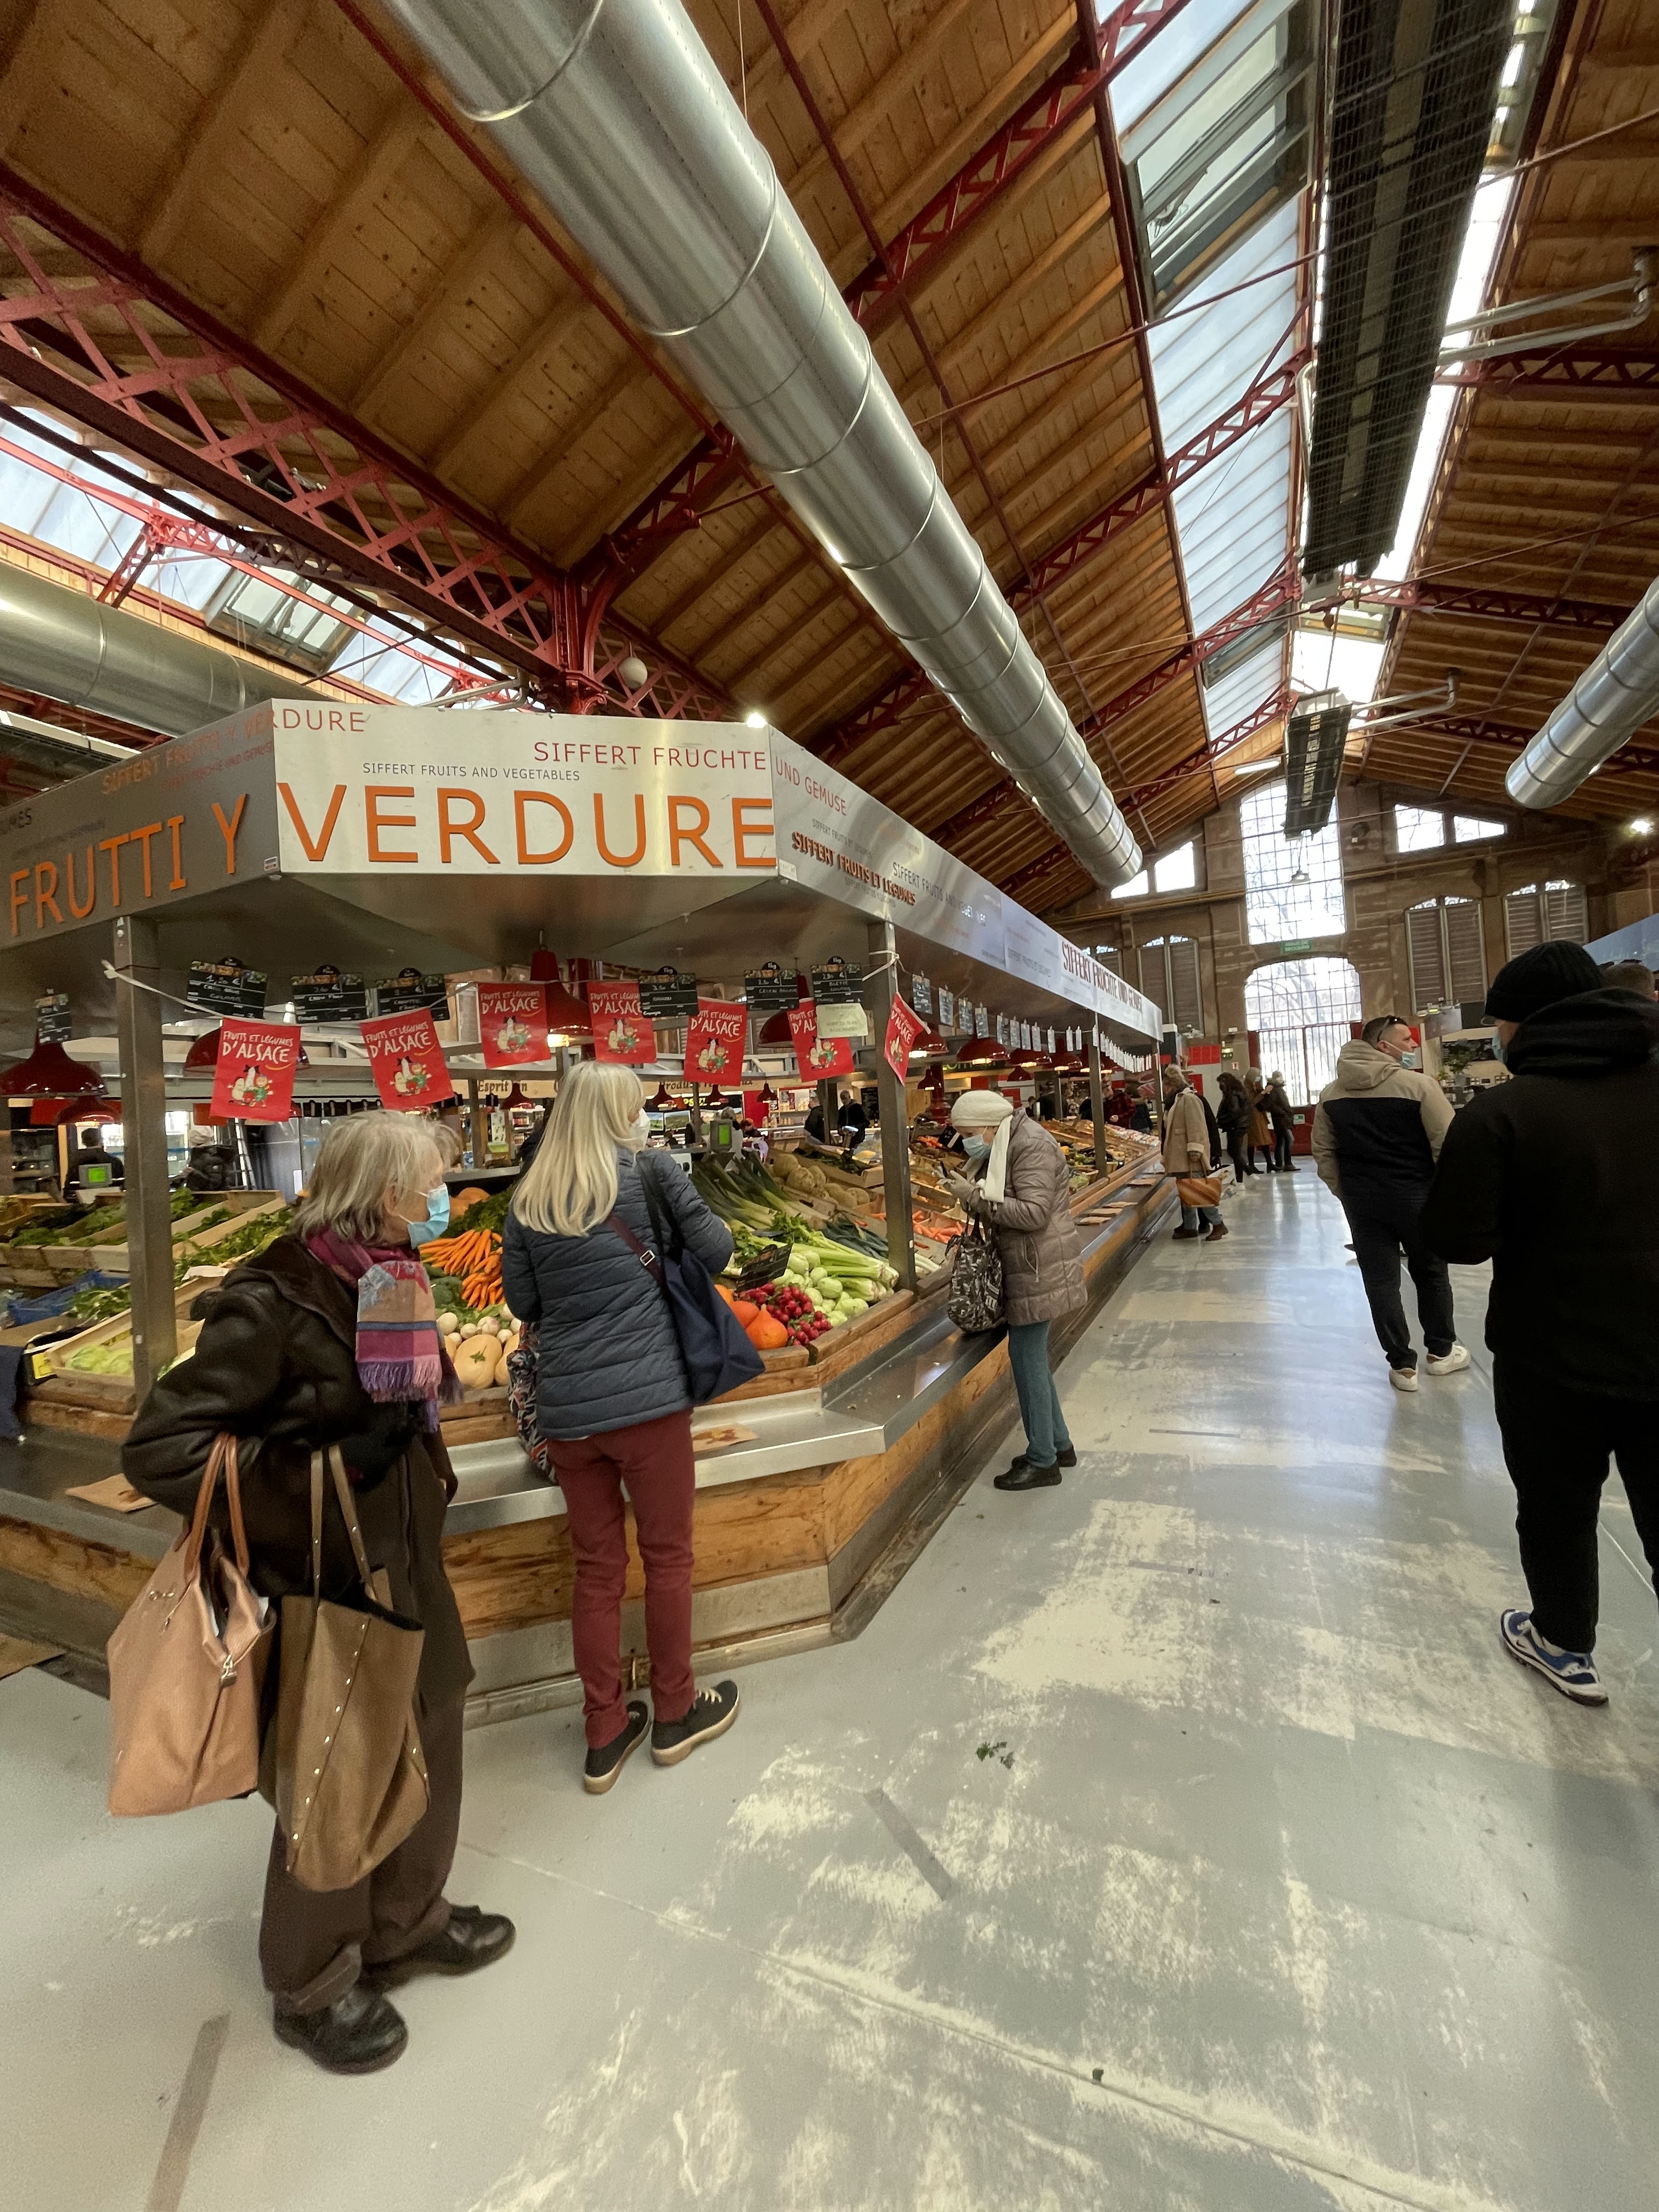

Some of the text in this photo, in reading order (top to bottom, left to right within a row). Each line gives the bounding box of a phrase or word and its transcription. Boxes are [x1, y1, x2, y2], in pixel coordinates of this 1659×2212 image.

[363, 762, 580, 782] SIFFERT FRUITS AND VEGETABLES
[533, 741, 847, 816] SIFFERT FRUCHTE UND GEMUSE
[9, 815, 187, 938] FRUTTI
[211, 793, 249, 875] Y
[276, 782, 777, 869] VERDURE
[792, 830, 836, 867] SIFFERT
[837, 853, 871, 885] FRUITS
[871, 871, 882, 890] ET
[882, 877, 916, 906] LEGUMES
[893, 861, 920, 889] SIFFERT
[922, 878, 944, 901] FRUITS
[1062, 940, 1092, 984] SIFFERT
[482, 996, 539, 1014] D'ALSACE
[592, 999, 643, 1015] D'ALSACE
[807, 1009, 815, 1018] ET
[223, 1031, 247, 1042] FRUITS
[249, 1034, 261, 1042] ET
[365, 1030, 388, 1044] FRUITS
[388, 1027, 399, 1037] ET
[691, 1017, 741, 1037] D'ALSACE
[792, 1018, 817, 1035] D'AL
[222, 1041, 290, 1064] D'ALSACE
[369, 1031, 432, 1058] D'ALSACE
[478, 1080, 509, 1093] Esprit
